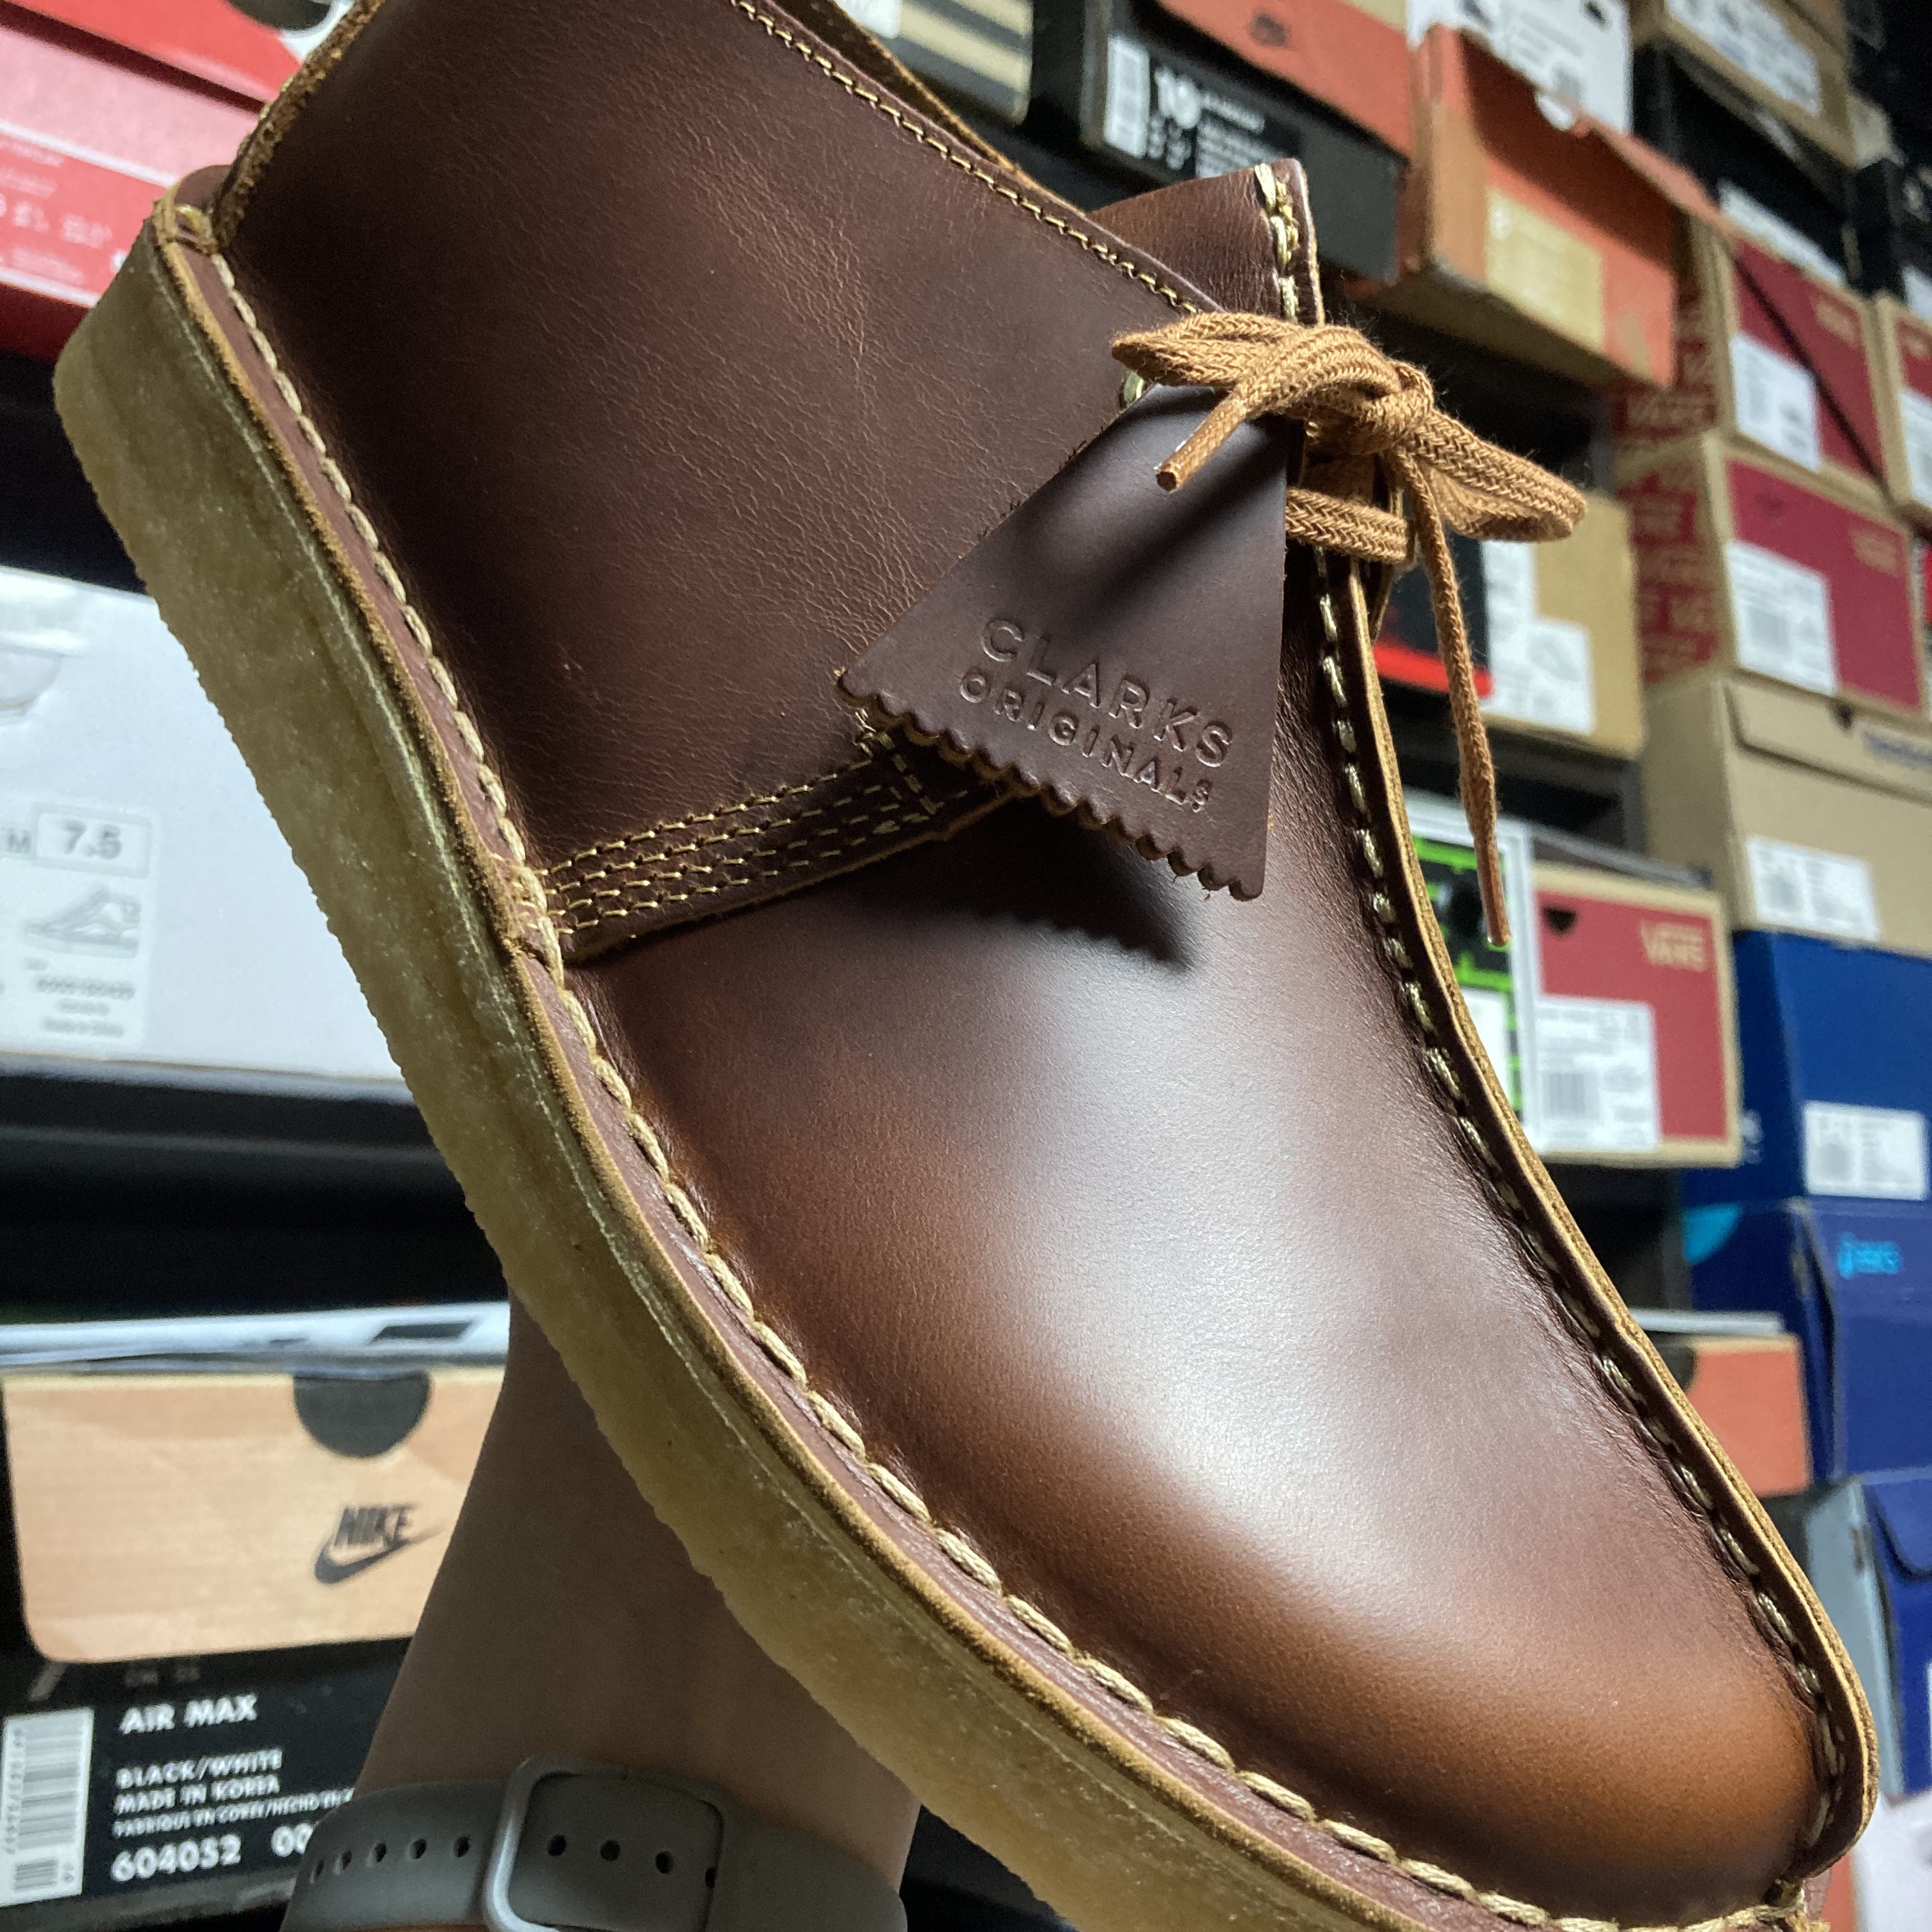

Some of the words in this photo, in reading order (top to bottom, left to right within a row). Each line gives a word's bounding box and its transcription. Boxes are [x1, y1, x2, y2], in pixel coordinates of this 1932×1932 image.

[980, 617, 1233, 768] CLARKS
[958, 668, 1213, 813] ORIGINALS
[63, 820, 123, 860] 7.5
[334, 1503, 417, 1546] NIKE
[119, 1704, 176, 1735] AIR
[183, 1693, 257, 1728] MAX
[115, 1747, 283, 1789] BLACK/WHITE
[114, 1787, 176, 1815] MADE
[180, 1783, 207, 1811] IN
[211, 1774, 281, 1800] KOREA
[111, 1833, 241, 1882] 604052
